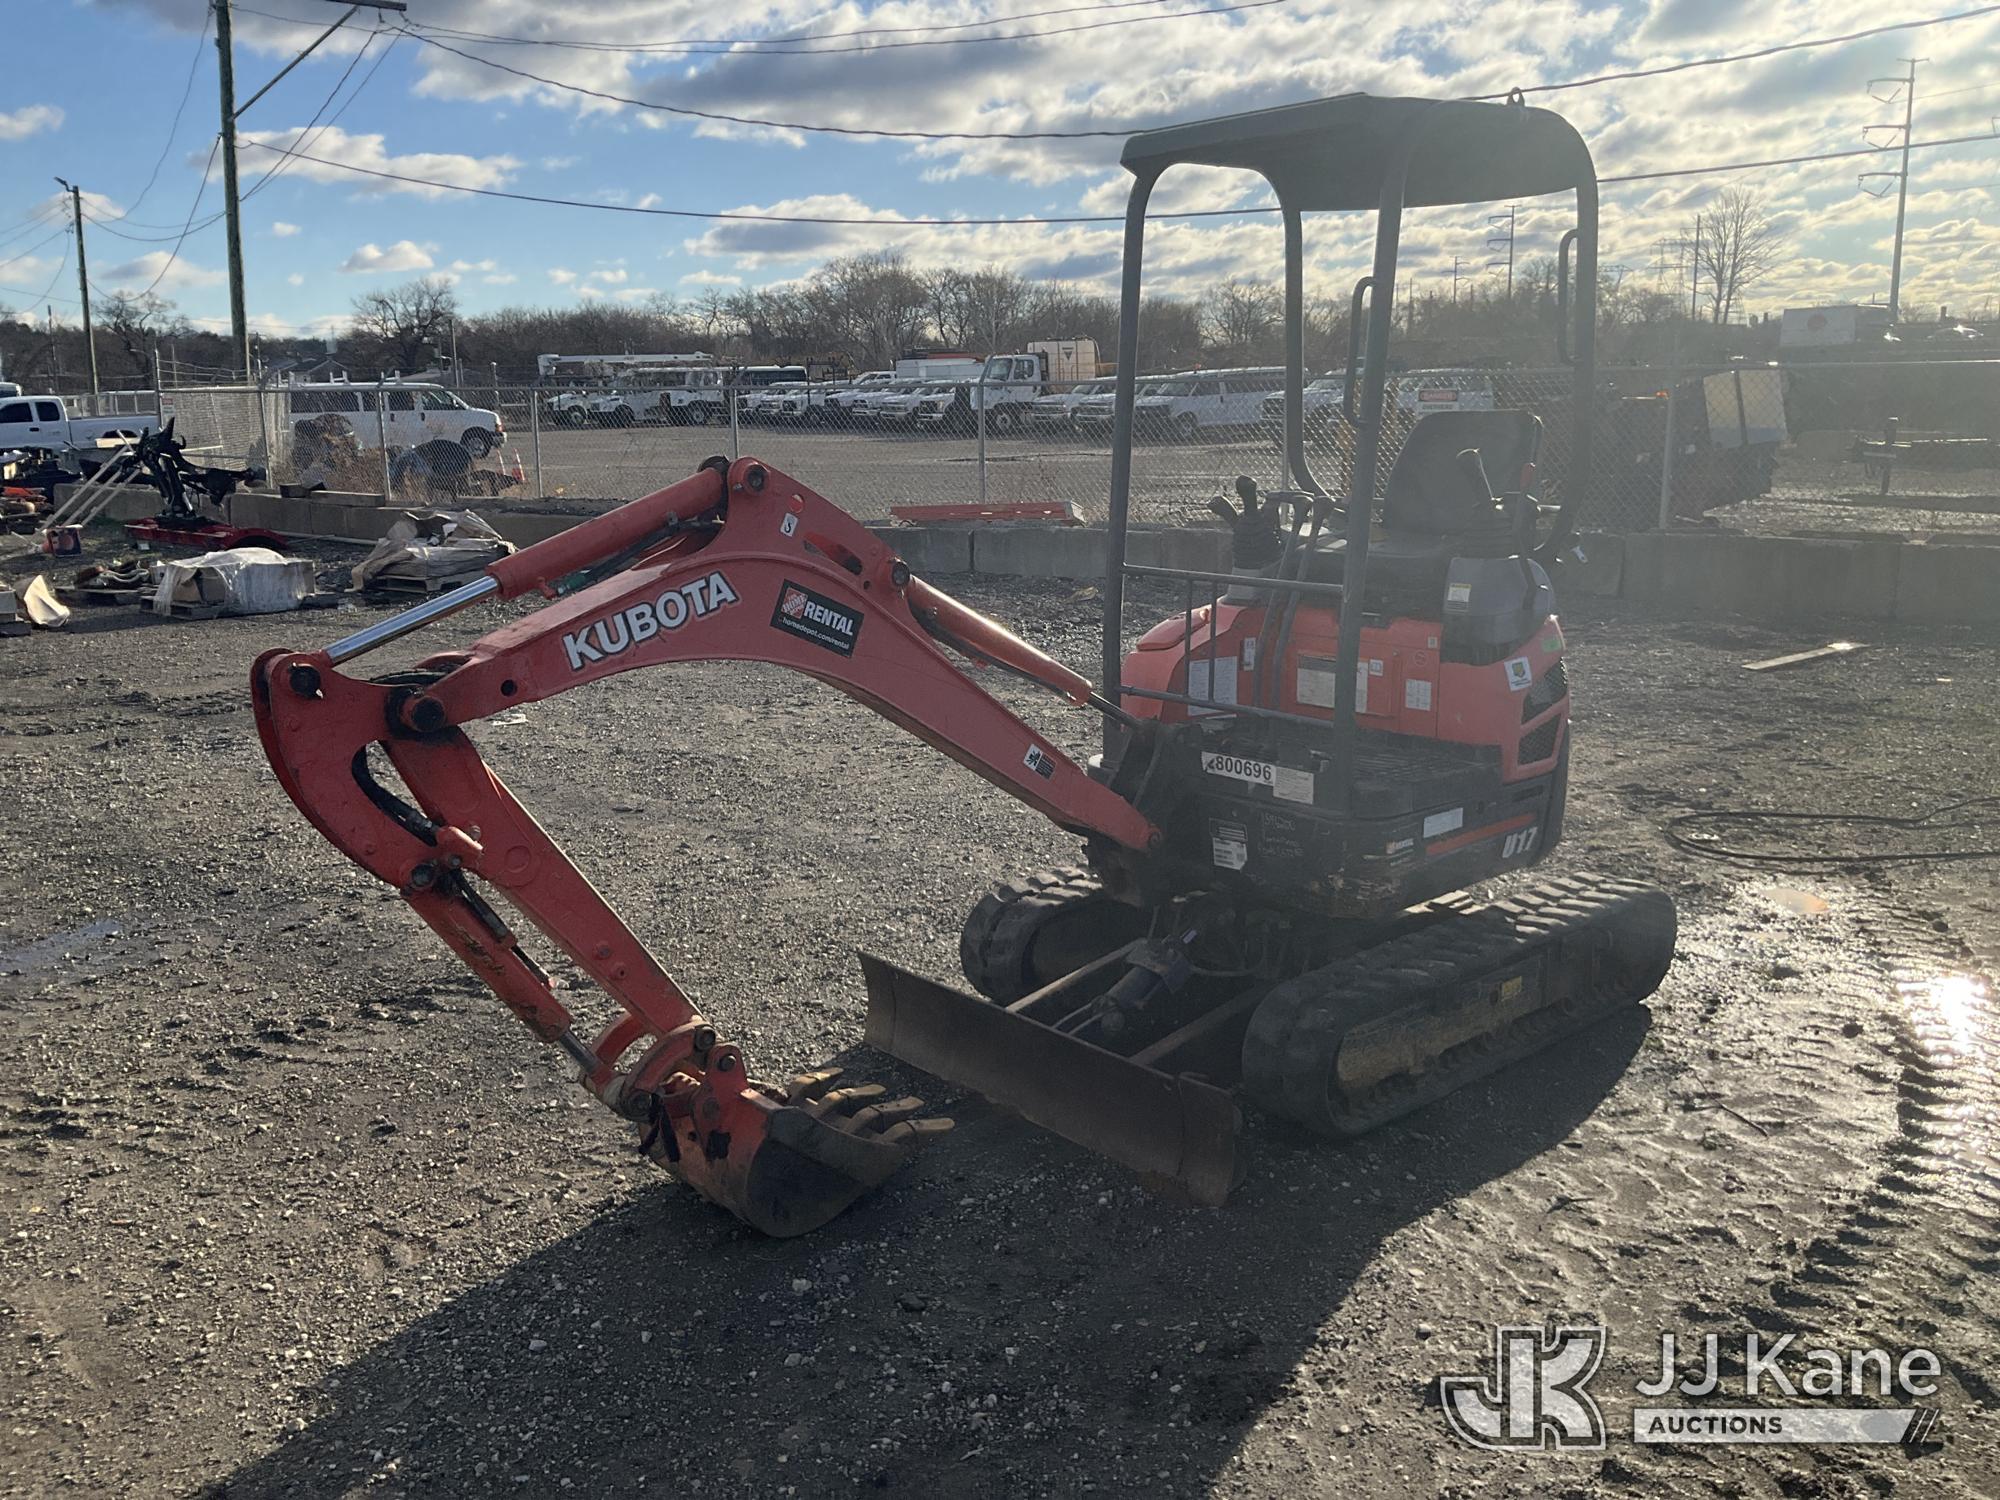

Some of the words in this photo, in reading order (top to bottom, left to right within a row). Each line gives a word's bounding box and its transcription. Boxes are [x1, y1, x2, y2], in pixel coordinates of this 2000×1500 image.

[562, 571, 738, 671] KUBOTA
[782, 617, 850, 650] homedepot.com/rental
[803, 600, 854, 636] RENTAL
[1502, 826, 1538, 858] U17
